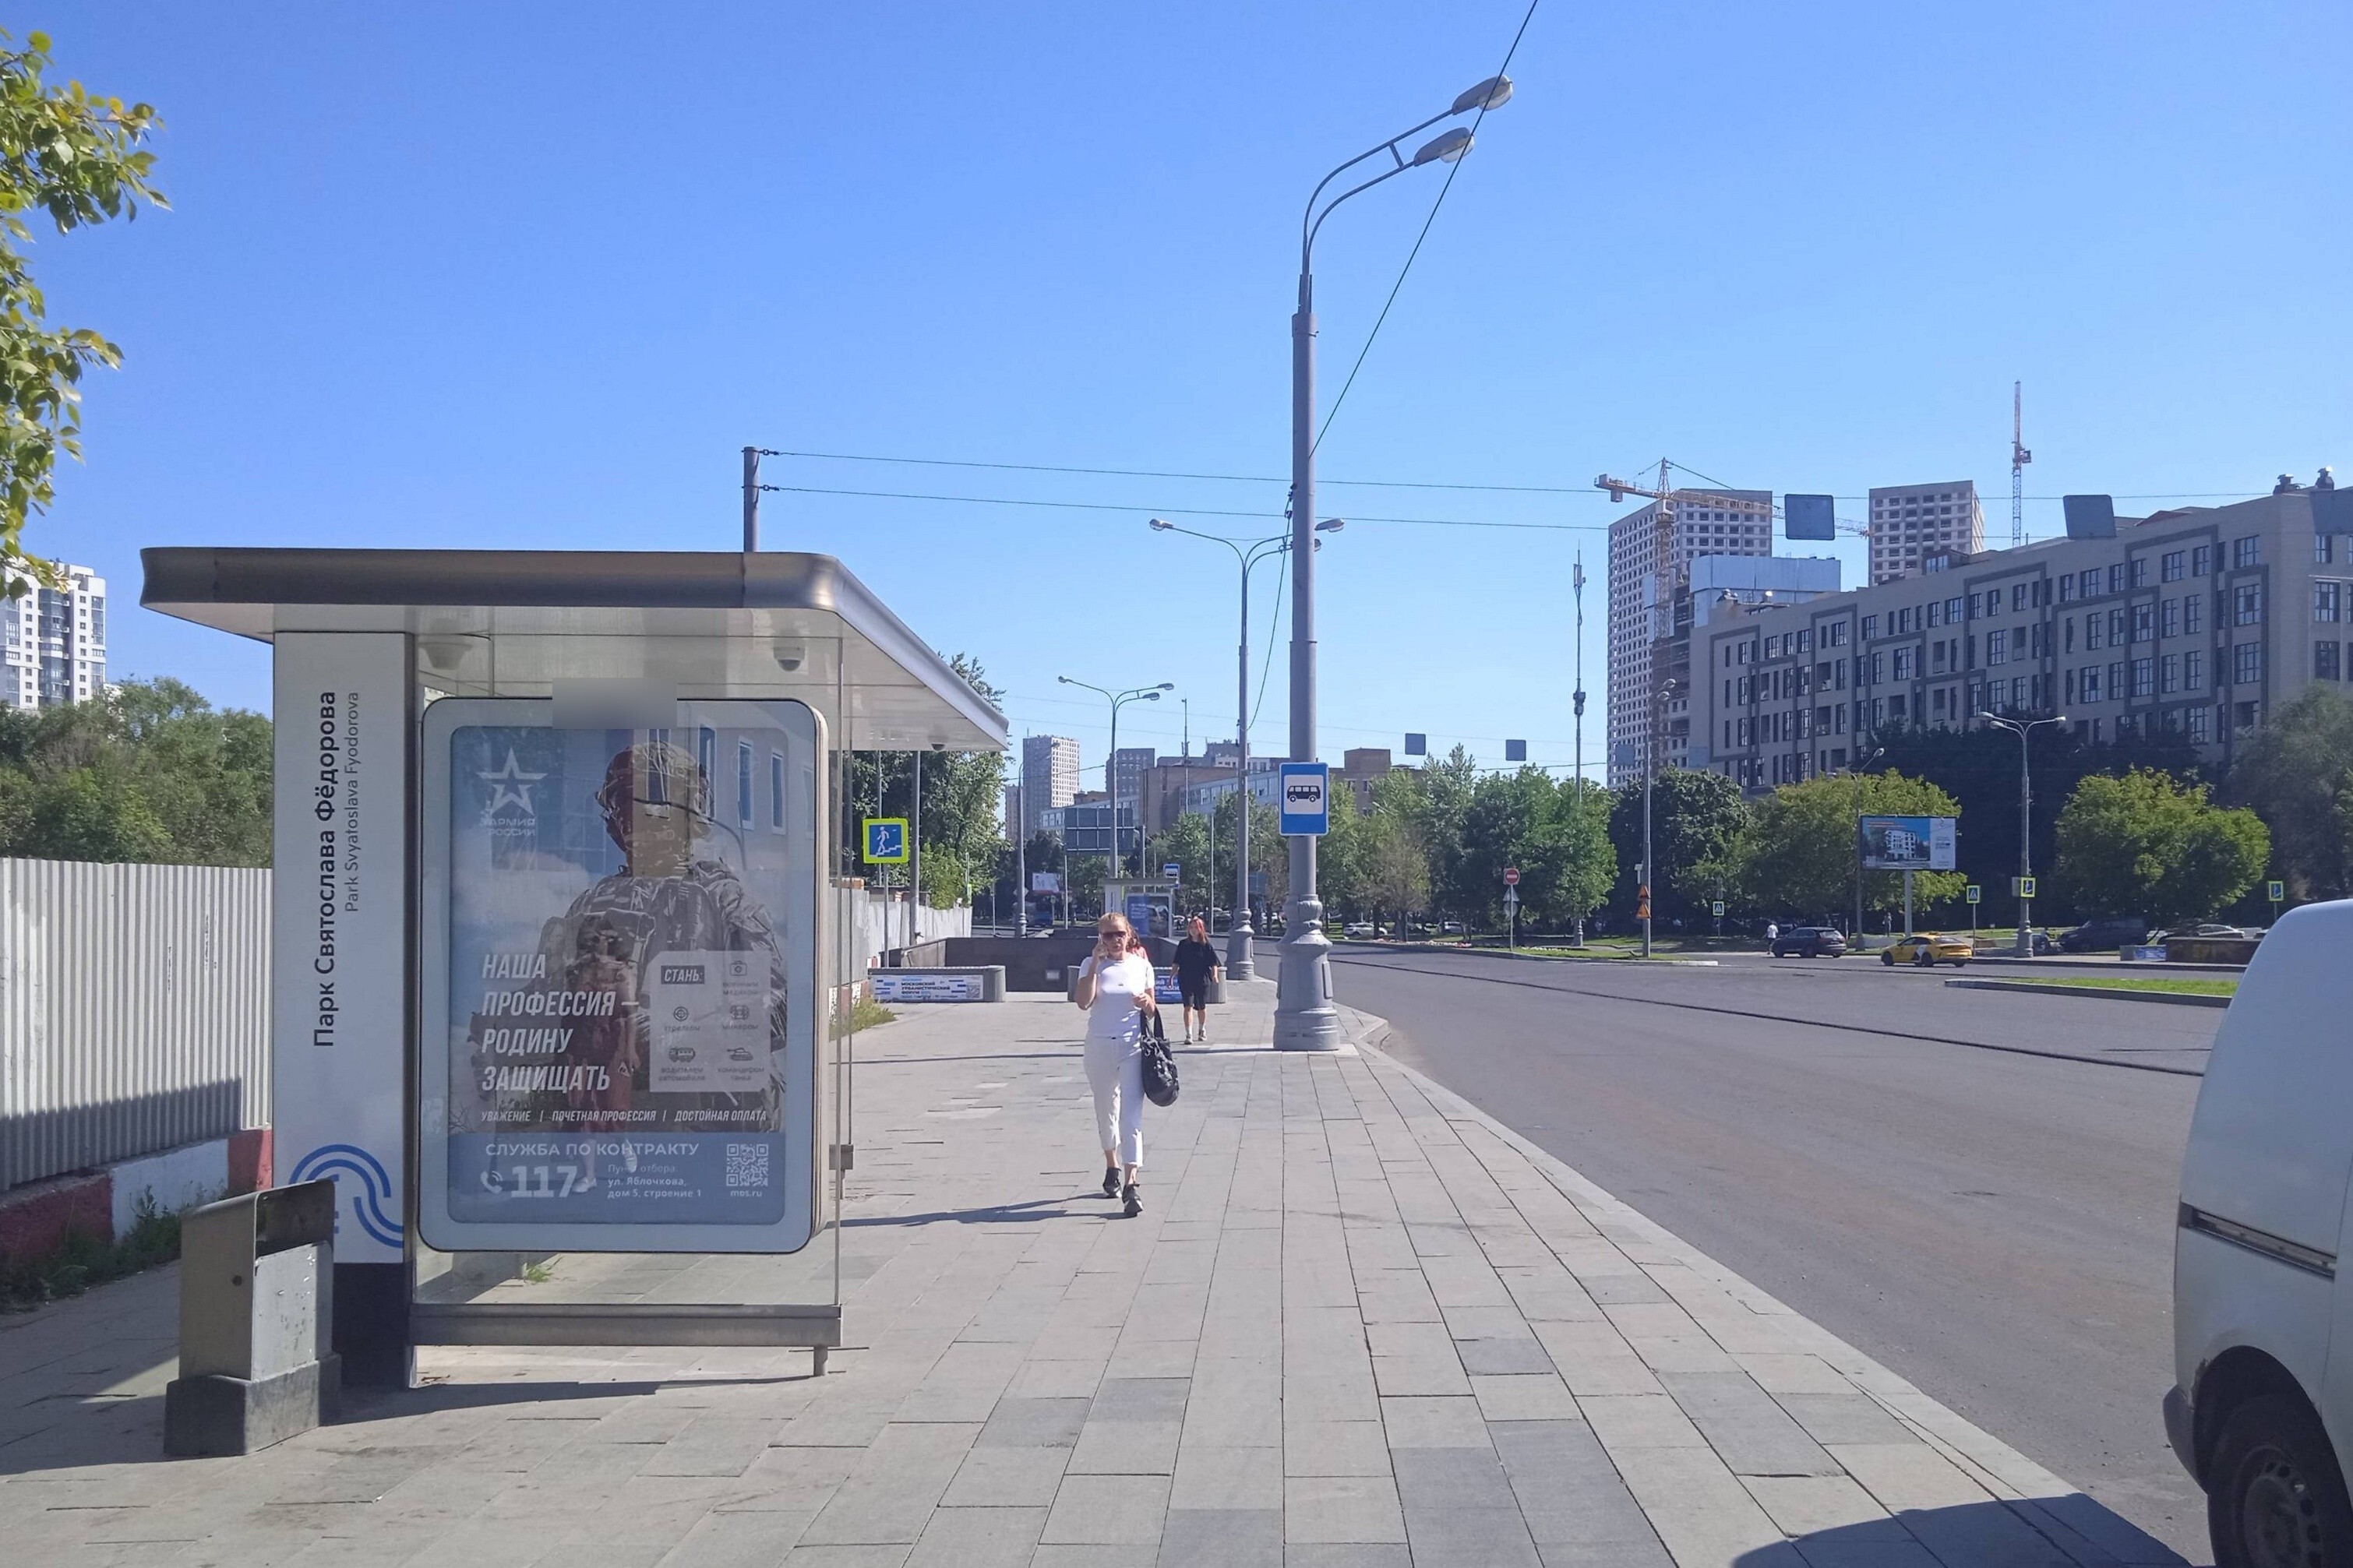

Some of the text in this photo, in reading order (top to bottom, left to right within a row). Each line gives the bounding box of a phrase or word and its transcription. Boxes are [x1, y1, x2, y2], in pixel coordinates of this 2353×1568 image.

[344, 692, 361, 912] Park Svyatoslava Fyodorova
[314, 692, 339, 1046] Парк Святослава Фёдорова
[482, 954, 545, 978] НАША
[664, 969, 703, 982] СТАНЬ:
[482, 991, 616, 1016] ПРОФЕССИЯ
[482, 1028, 573, 1056] РОДИНУ
[482, 1066, 610, 1094] ЗАЩИЩАТЬ
[482, 1111, 531, 1122] УВАЖЕНИЕ
[552, 1111, 599, 1122] ПОЧЕТНАЯ
[601, 1111, 656, 1122] ПРОФЕССИЯ
[675, 1108, 728, 1122] ДОСТОЙНАЯ
[731, 1110, 767, 1122] ОПЛАТА
[485, 1143, 700, 1156] СЛУЖБА ПО КОНТРАКТУ
[511, 1165, 578, 1198] 117
[608, 1179, 623, 1188] ул.
[607, 1190, 630, 1200] дом
[644, 1190, 693, 1199] строение
[697, 1189, 702, 1197] 1
